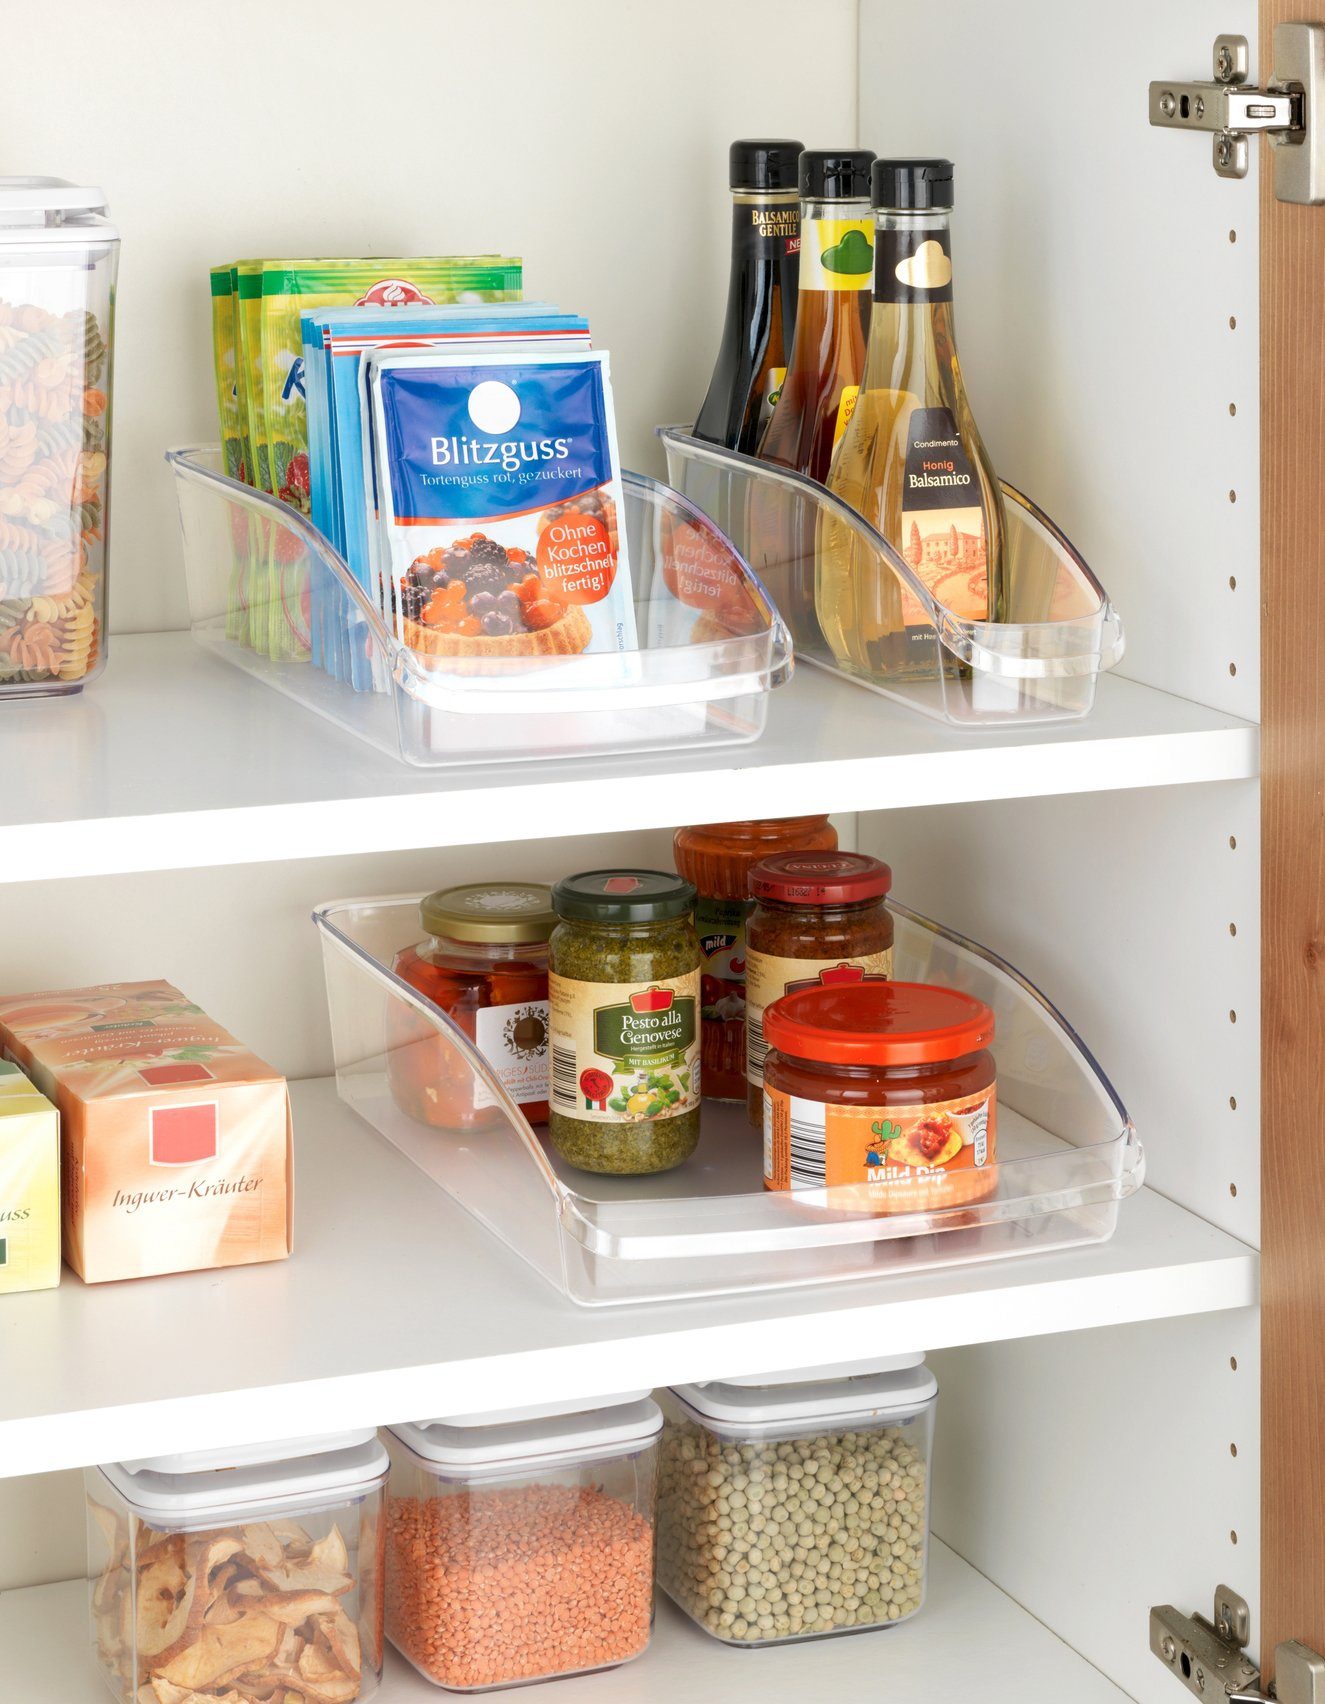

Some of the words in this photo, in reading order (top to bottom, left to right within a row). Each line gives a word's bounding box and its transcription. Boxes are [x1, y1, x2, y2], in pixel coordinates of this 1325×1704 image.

[752, 210, 800, 225] BALSAMICO
[759, 224, 797, 237] GENTILE
[789, 239, 801, 249] NE
[914, 440, 959, 448] Condimento
[923, 461, 954, 471] Honig
[420, 472, 489, 488] Tortenguss
[493, 471, 515, 484] rot,
[518, 467, 583, 484] gezuckert
[909, 471, 971, 488] Balsamico
[549, 524, 597, 543] Ohne
[547, 540, 607, 562] Kochen
[561, 572, 605, 593] fertig!
[616, 622, 624, 650] orschlag
[705, 935, 726, 951] mild
[622, 1015, 660, 1030] Pesto
[661, 1010, 682, 1026] alla
[620, 1027, 682, 1045] Genovese
[629, 1058, 641, 1066] MIT
[642, 1053, 675, 1066] BASILIKUM
[867, 1165, 912, 1186] Mild
[916, 1163, 947, 1185] Dip
[112, 1175, 264, 1214] Ingwer-Kräuter
